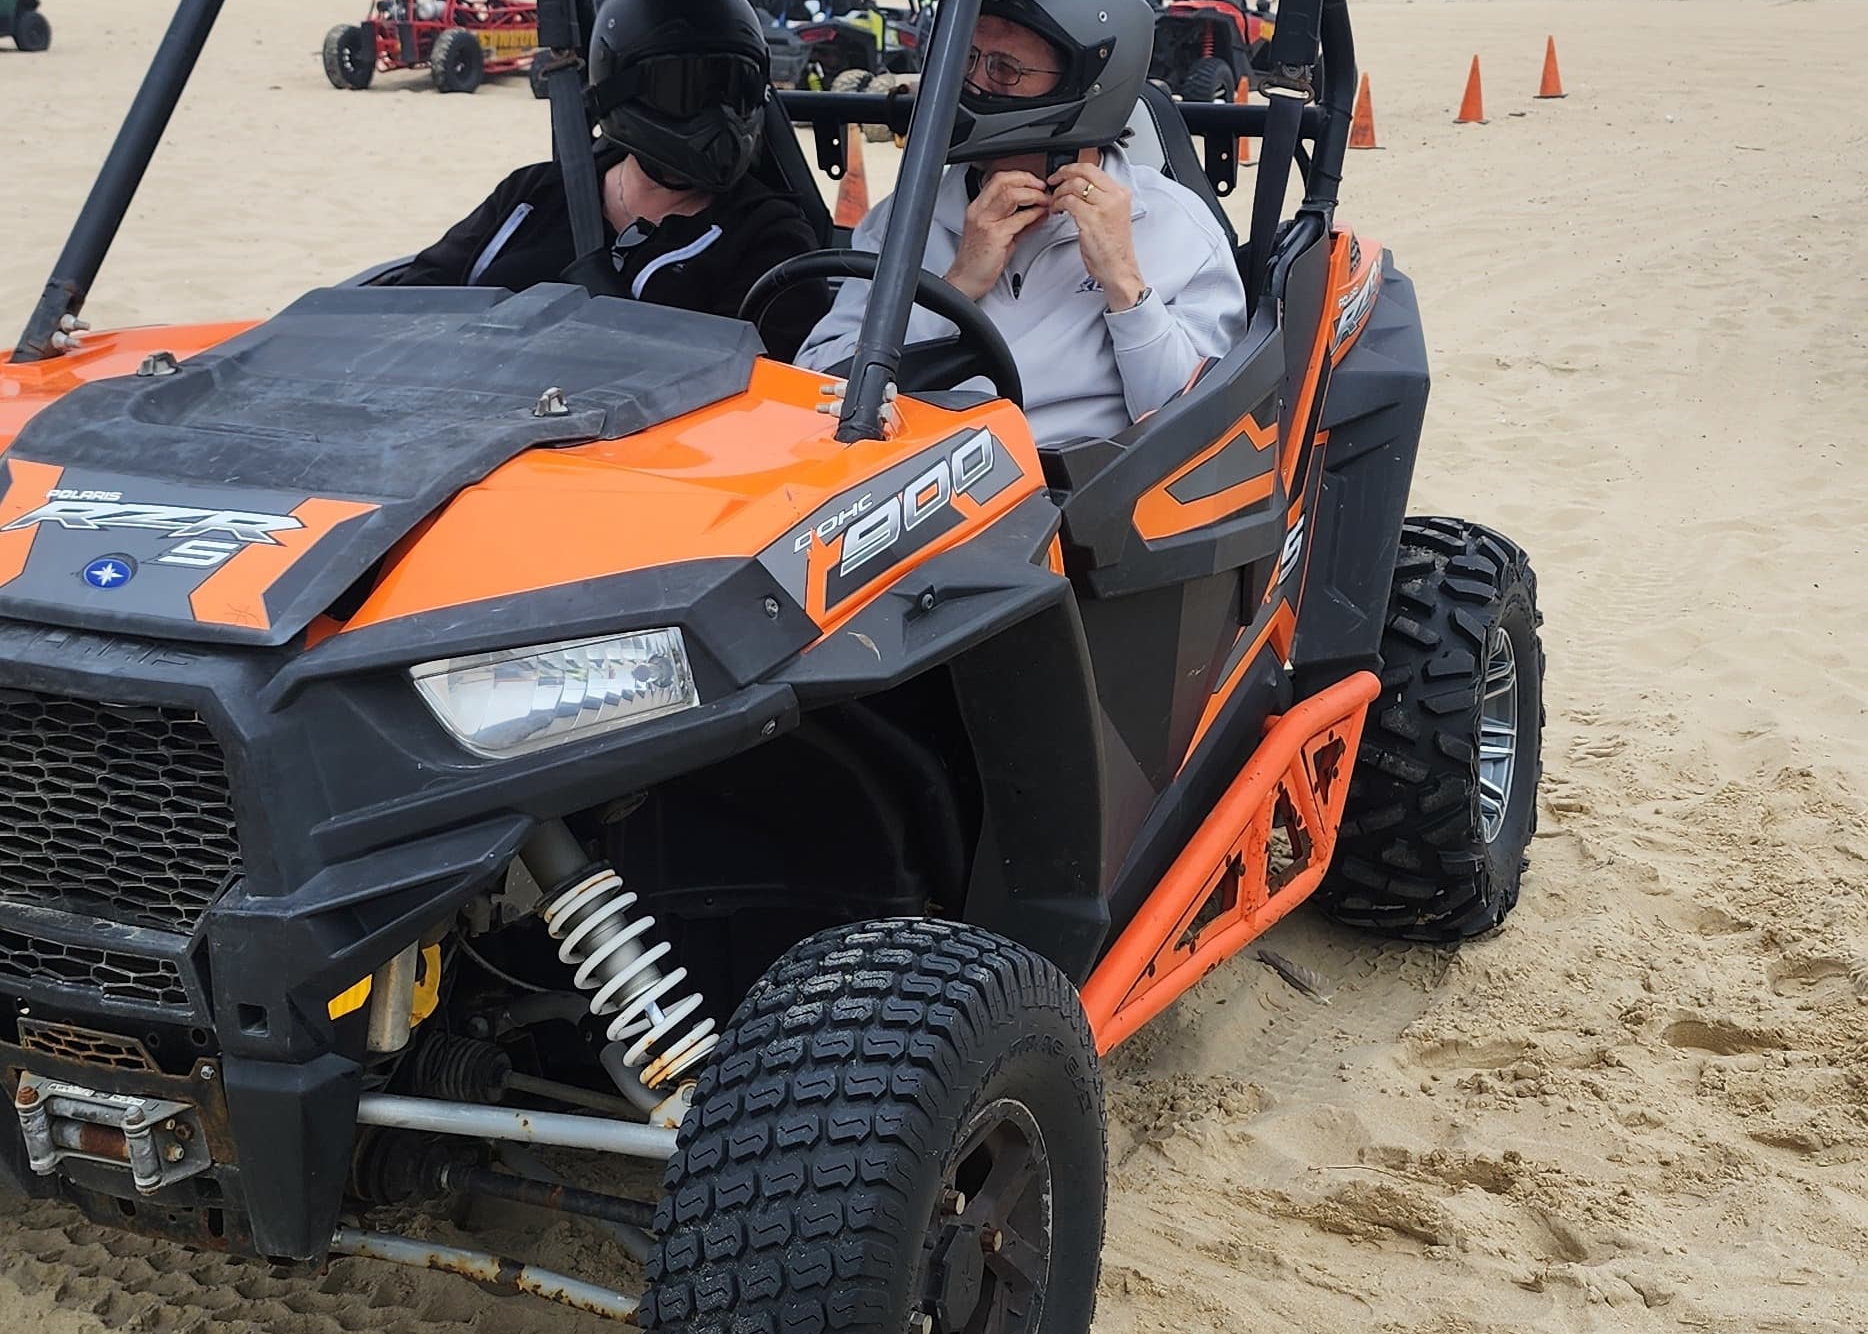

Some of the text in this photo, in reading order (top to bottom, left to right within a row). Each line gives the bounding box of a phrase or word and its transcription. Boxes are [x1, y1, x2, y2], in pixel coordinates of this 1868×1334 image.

[46, 489, 122, 502] POLARIS
[840, 427, 995, 578] 900
[0, 500, 306, 546] RZR
[793, 492, 873, 554] DOHC
[158, 539, 242, 567] S
